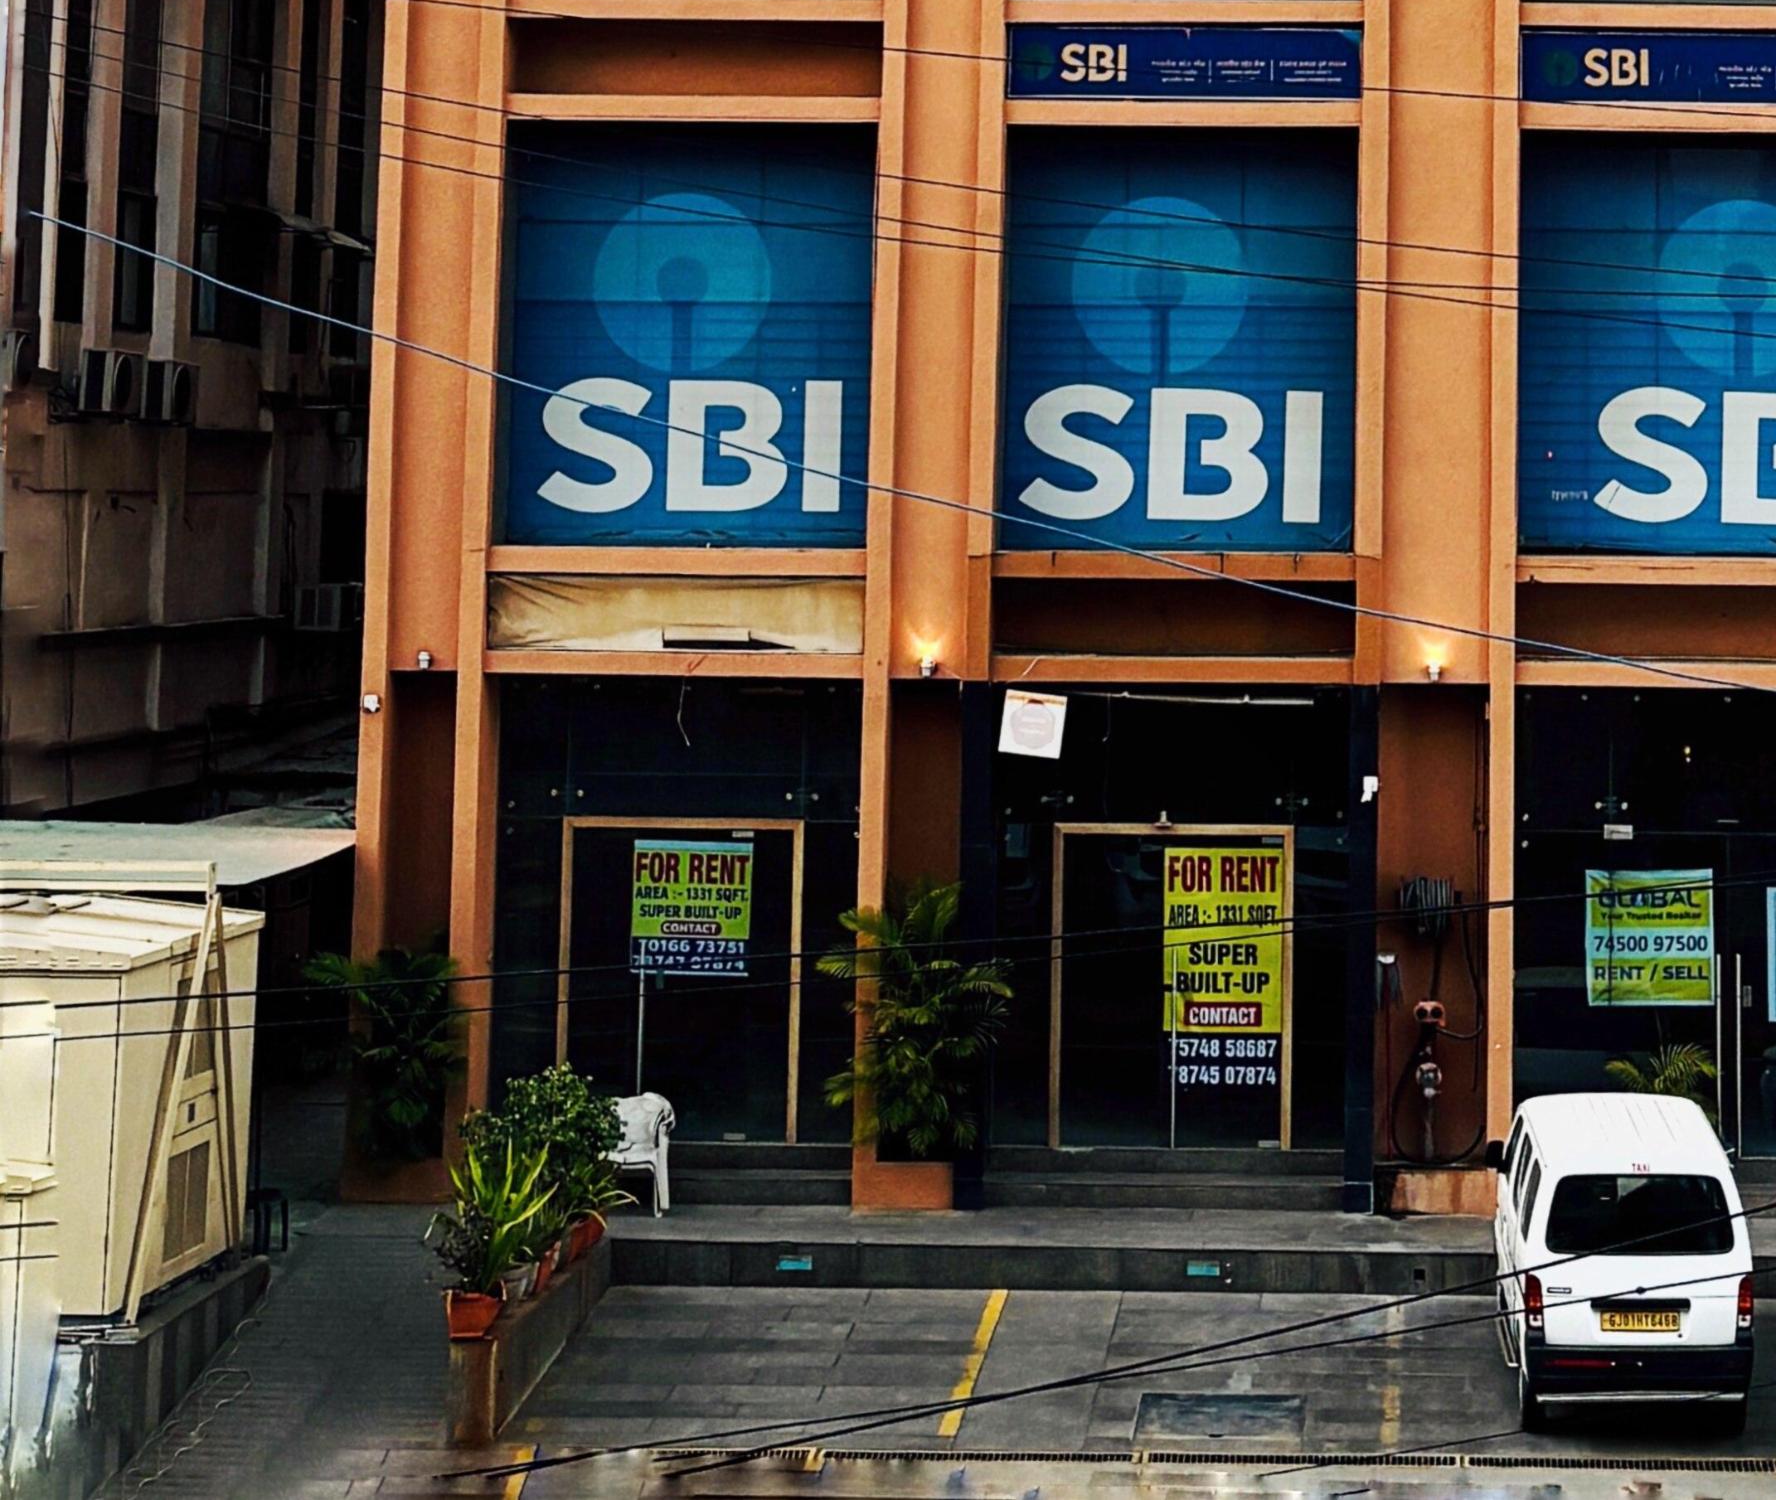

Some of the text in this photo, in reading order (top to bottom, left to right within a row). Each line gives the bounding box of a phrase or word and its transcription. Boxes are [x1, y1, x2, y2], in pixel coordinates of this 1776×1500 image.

[1060, 43, 1127, 82] SBI
[1584, 48, 1650, 87] SBI
[537, 377, 843, 514] SBI
[1018, 383, 1324, 524] SBI
[635, 852, 750, 885] FOR RENT
[1168, 856, 1280, 893] FOR RENT
[635, 886, 669, 900] AREA
[687, 888, 712, 900] 1331
[639, 905, 742, 920] SUPER BUILT-UP
[1168, 904, 1199, 927] AREA
[1216, 904, 1243, 924] 1331
[662, 923, 717, 934] CONTACT
[695, 941, 744, 954] 73751
[1593, 935, 1708, 952] 74500 97500
[1188, 943, 1258, 966] SUPER
[1594, 966, 1645, 980] RENT
[1662, 965, 1709, 980] SELL
[1176, 972, 1270, 994] BUILT-UP
[1189, 1007, 1257, 1025] CONTACT
[1225, 1039, 1277, 1058] 58687
[1225, 1066, 1277, 1085] 07874
